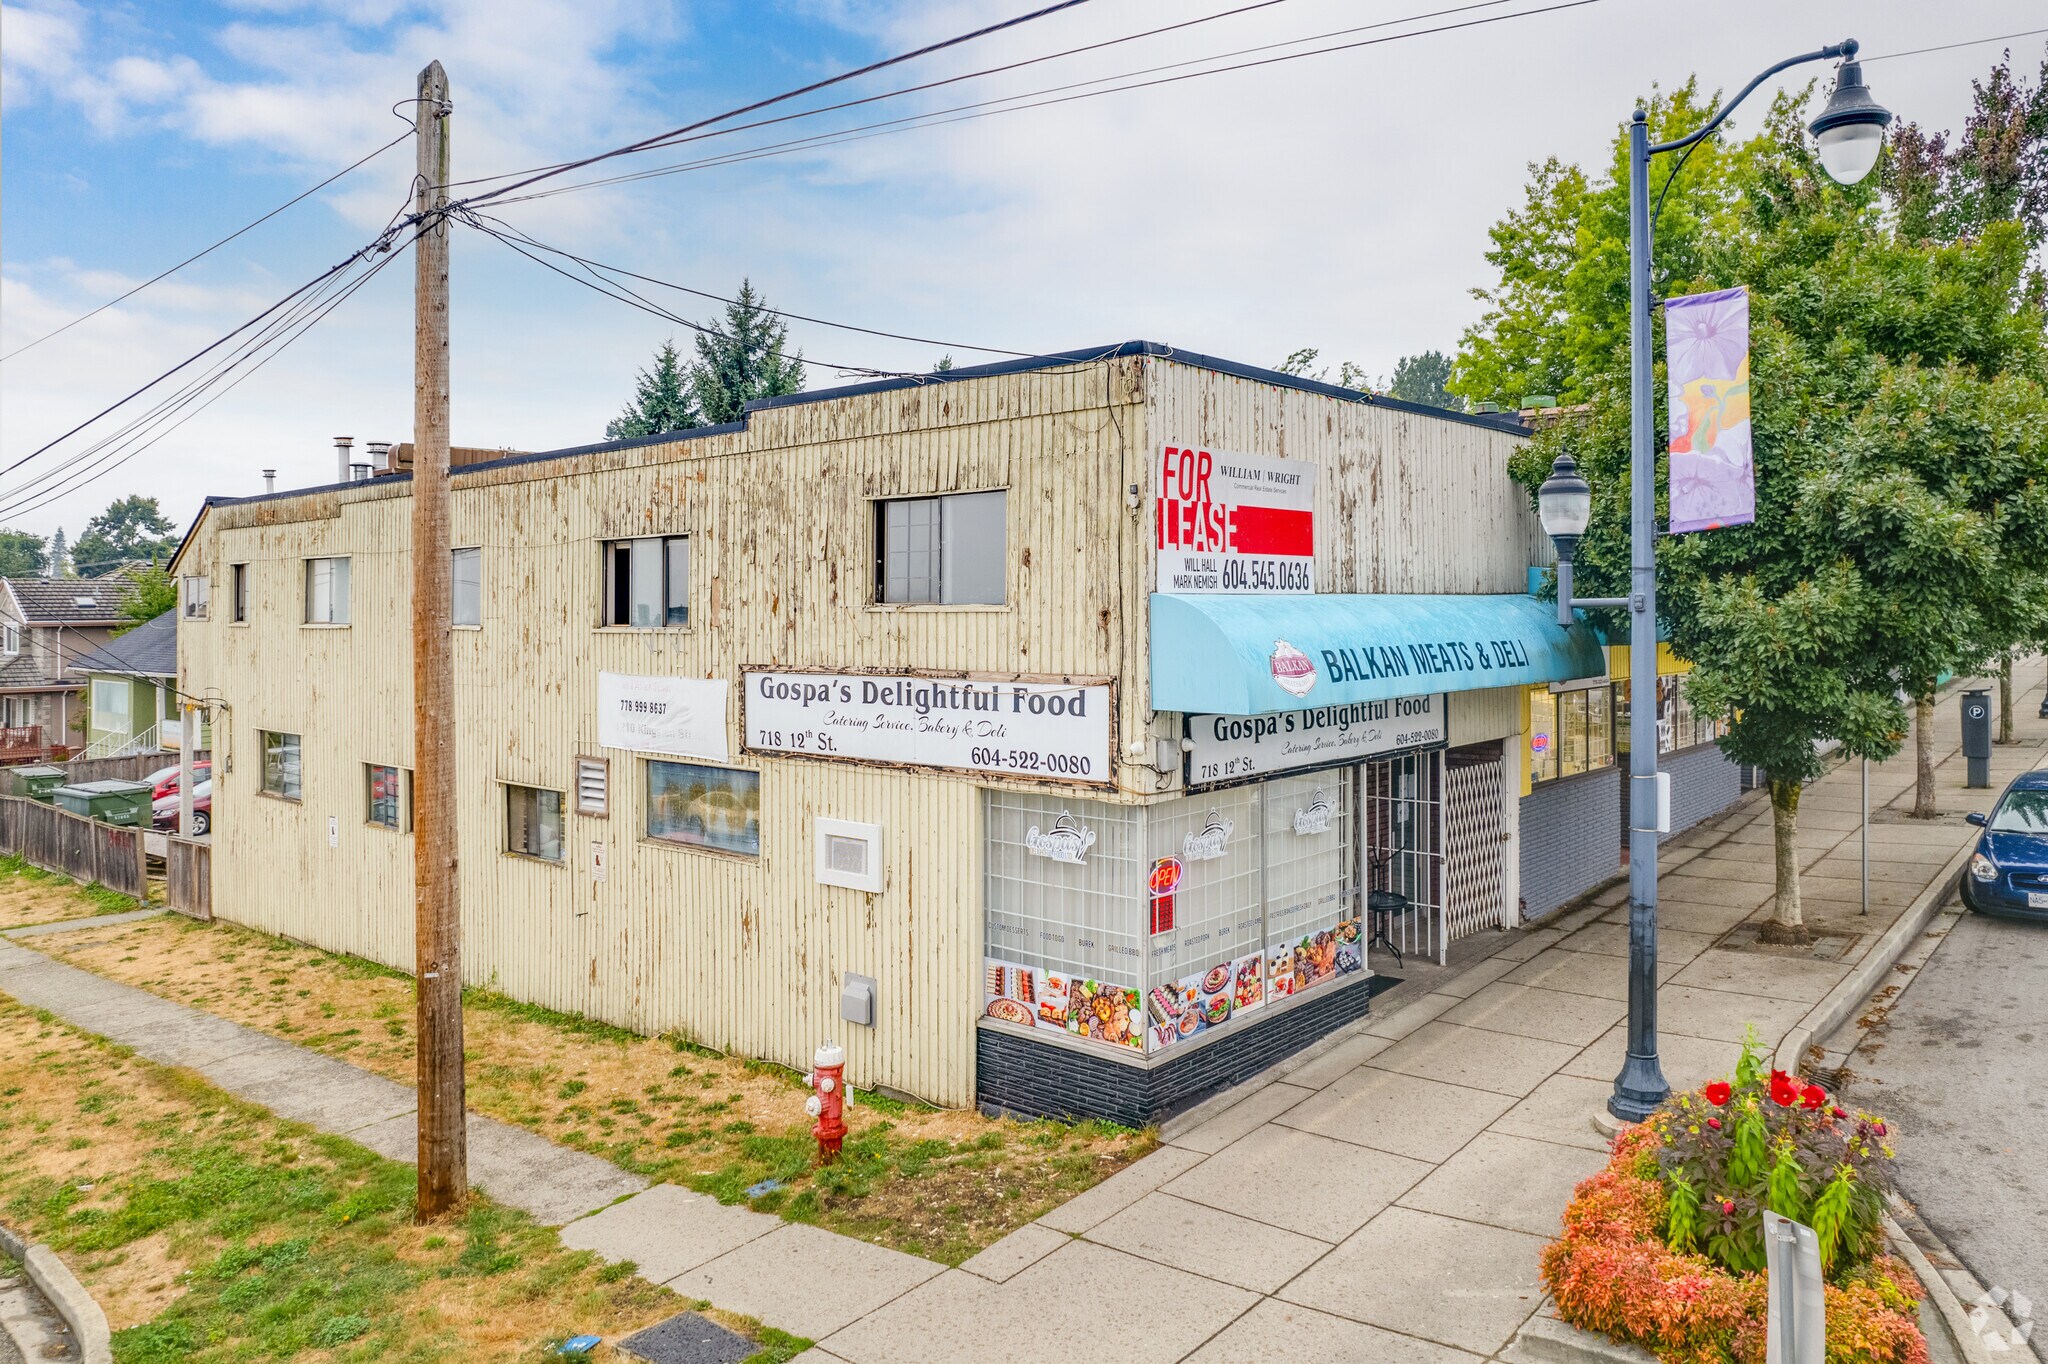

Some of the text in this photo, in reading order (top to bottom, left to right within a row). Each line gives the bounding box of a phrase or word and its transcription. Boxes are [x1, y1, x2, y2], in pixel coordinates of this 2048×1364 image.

[1163, 446, 1212, 503] FOR
[1220, 465, 1301, 485] WILLIAM WRIGHT
[1233, 482, 1253, 491] Commercial
[1164, 498, 1238, 554] LEASE
[1184, 558, 1217, 572] WILL HALL
[1222, 559, 1309, 591] 604.545.0636
[1173, 574, 1218, 589] MARK NEMISH
[1274, 659, 1311, 673] BALKAN
[1320, 639, 1530, 683] BALKAN MEATS & DELI
[620, 699, 667, 715] 778 999 8637
[760, 676, 1087, 718] Gospa's Delightful Food
[823, 710, 869, 733] Catering
[918, 716, 959, 740] Bakery
[961, 720, 974, 738] &
[977, 720, 1007, 738] Deli
[1214, 697, 1431, 744] Gospa's Delightful Food
[759, 730, 782, 747] 718
[817, 732, 837, 751] St.
[1281, 741, 1311, 756] Catering
[1338, 733, 1360, 748] Bakery
[1368, 728, 1382, 742] Deli
[1396, 728, 1439, 746] 604-522-0080
[971, 746, 1091, 776] 604-522-0080
[1201, 763, 1219, 779] 718
[1242, 756, 1256, 772] St.
[1150, 865, 1180, 889] OPEN
[1078, 938, 1095, 949] BUREK
